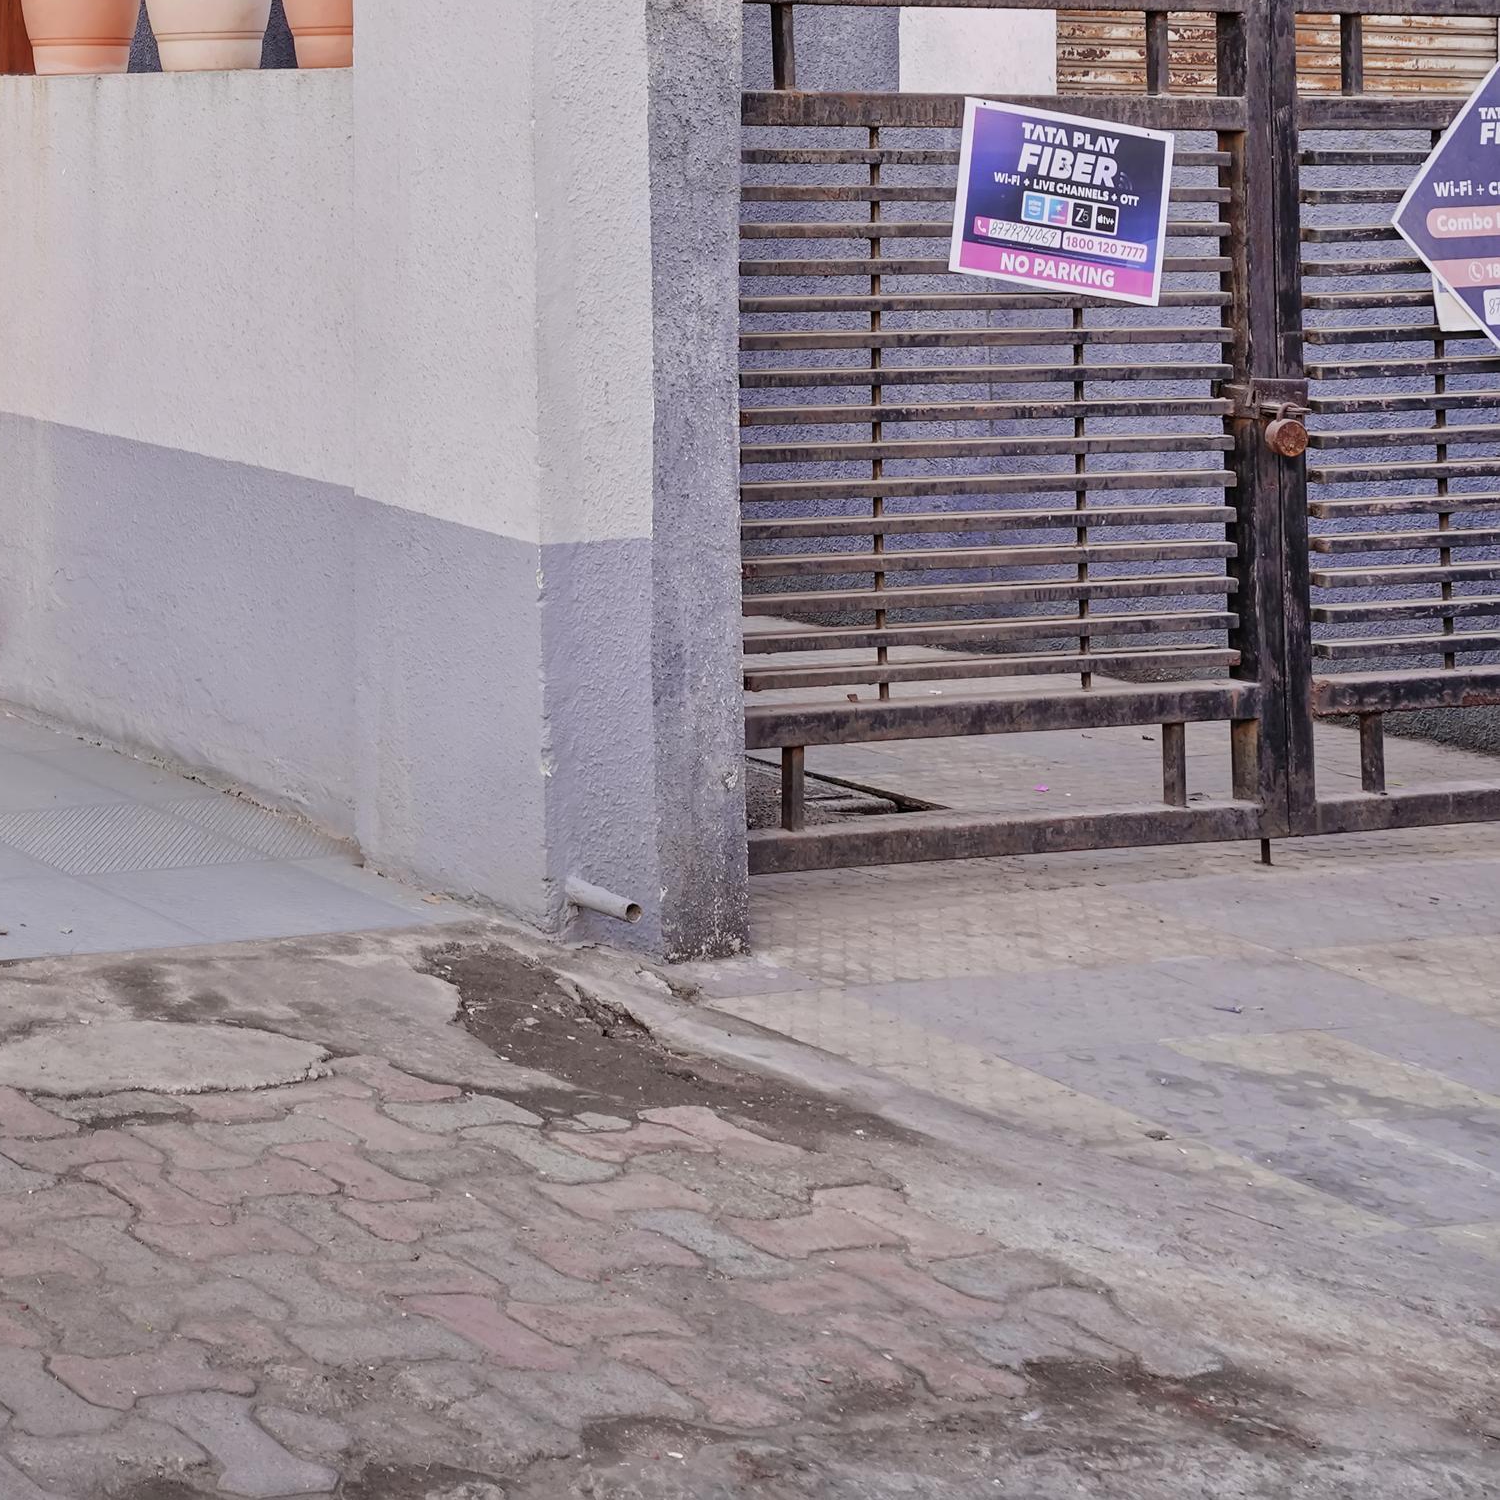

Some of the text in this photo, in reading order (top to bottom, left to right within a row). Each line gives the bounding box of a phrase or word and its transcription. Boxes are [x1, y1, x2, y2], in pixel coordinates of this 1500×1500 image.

[1021, 121, 1120, 155] TATA PLAY
[1017, 142, 1118, 188] FIBER
[1033, 178, 1055, 192] LIVE
[1056, 182, 1110, 202] CHANNELS
[1120, 193, 1140, 207] OTT
[1433, 179, 1473, 198] Wi-Fi
[1436, 211, 1493, 232] Combo
[1065, 235, 1095, 250] 1800
[1097, 240, 1118, 254] 120
[1120, 244, 1146, 260] 7777
[1000, 252, 1030, 273] NO
[1033, 258, 1116, 288] PARKING
